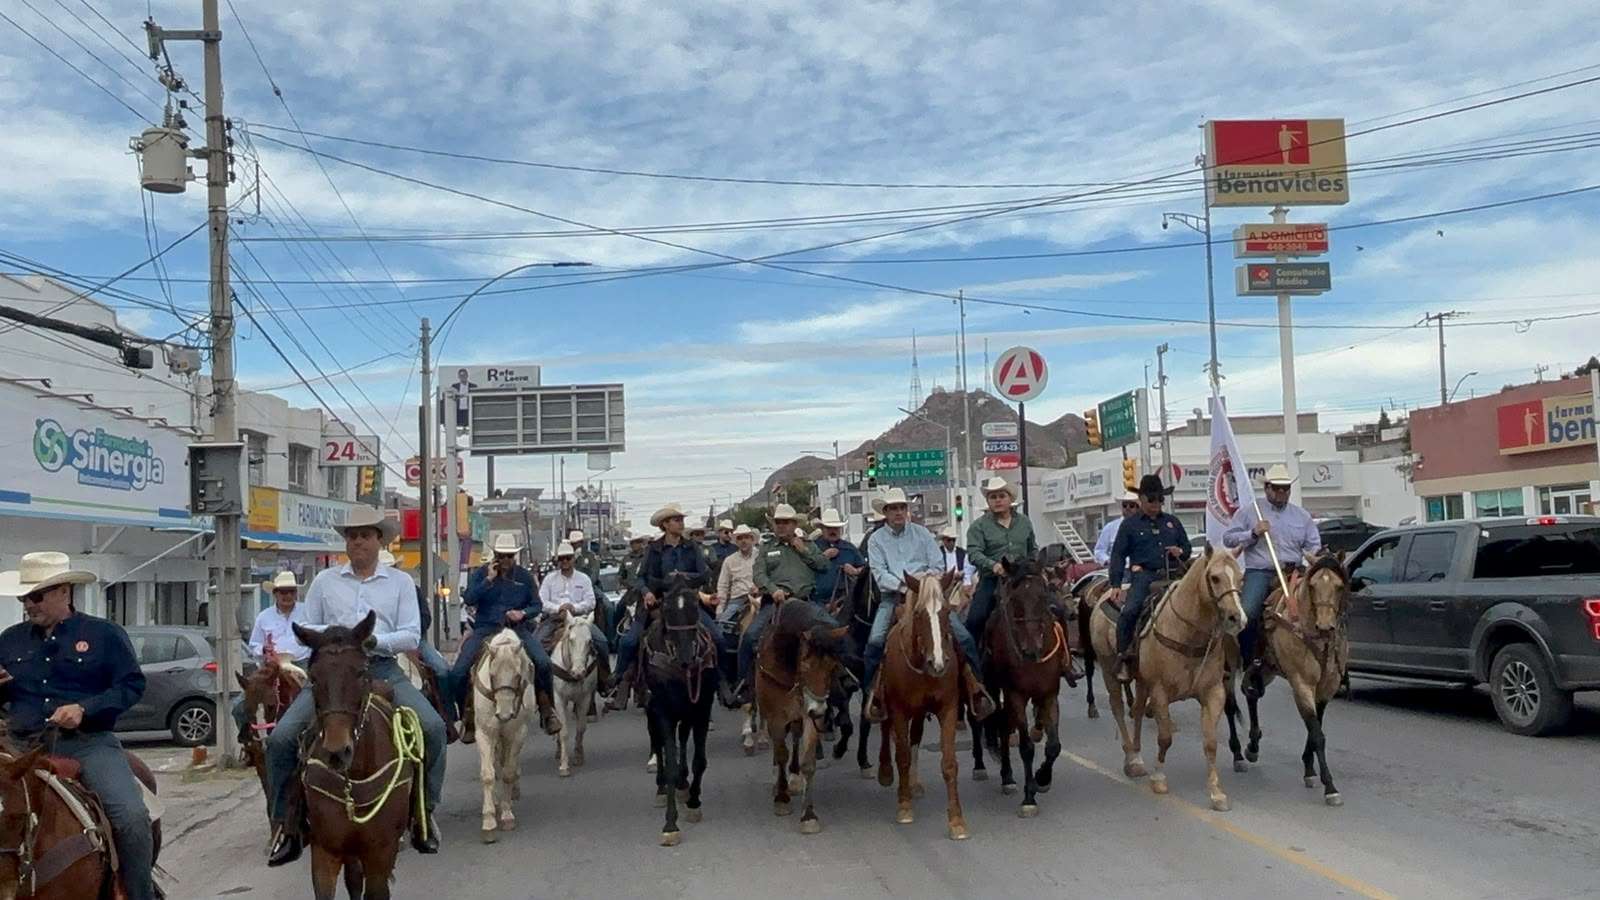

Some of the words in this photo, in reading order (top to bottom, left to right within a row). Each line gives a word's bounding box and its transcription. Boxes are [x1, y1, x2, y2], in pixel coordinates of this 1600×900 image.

[1217, 171, 1344, 193] benavides
[1249, 231, 1257, 240] A
[1262, 230, 1325, 240] DOMICILIO
[1276, 268, 1326, 277] Consultorio
[1555, 404, 1593, 418] farma
[1547, 411, 1596, 443] ben
[72, 430, 163, 489] Sinergia
[326, 441, 356, 461] 24
